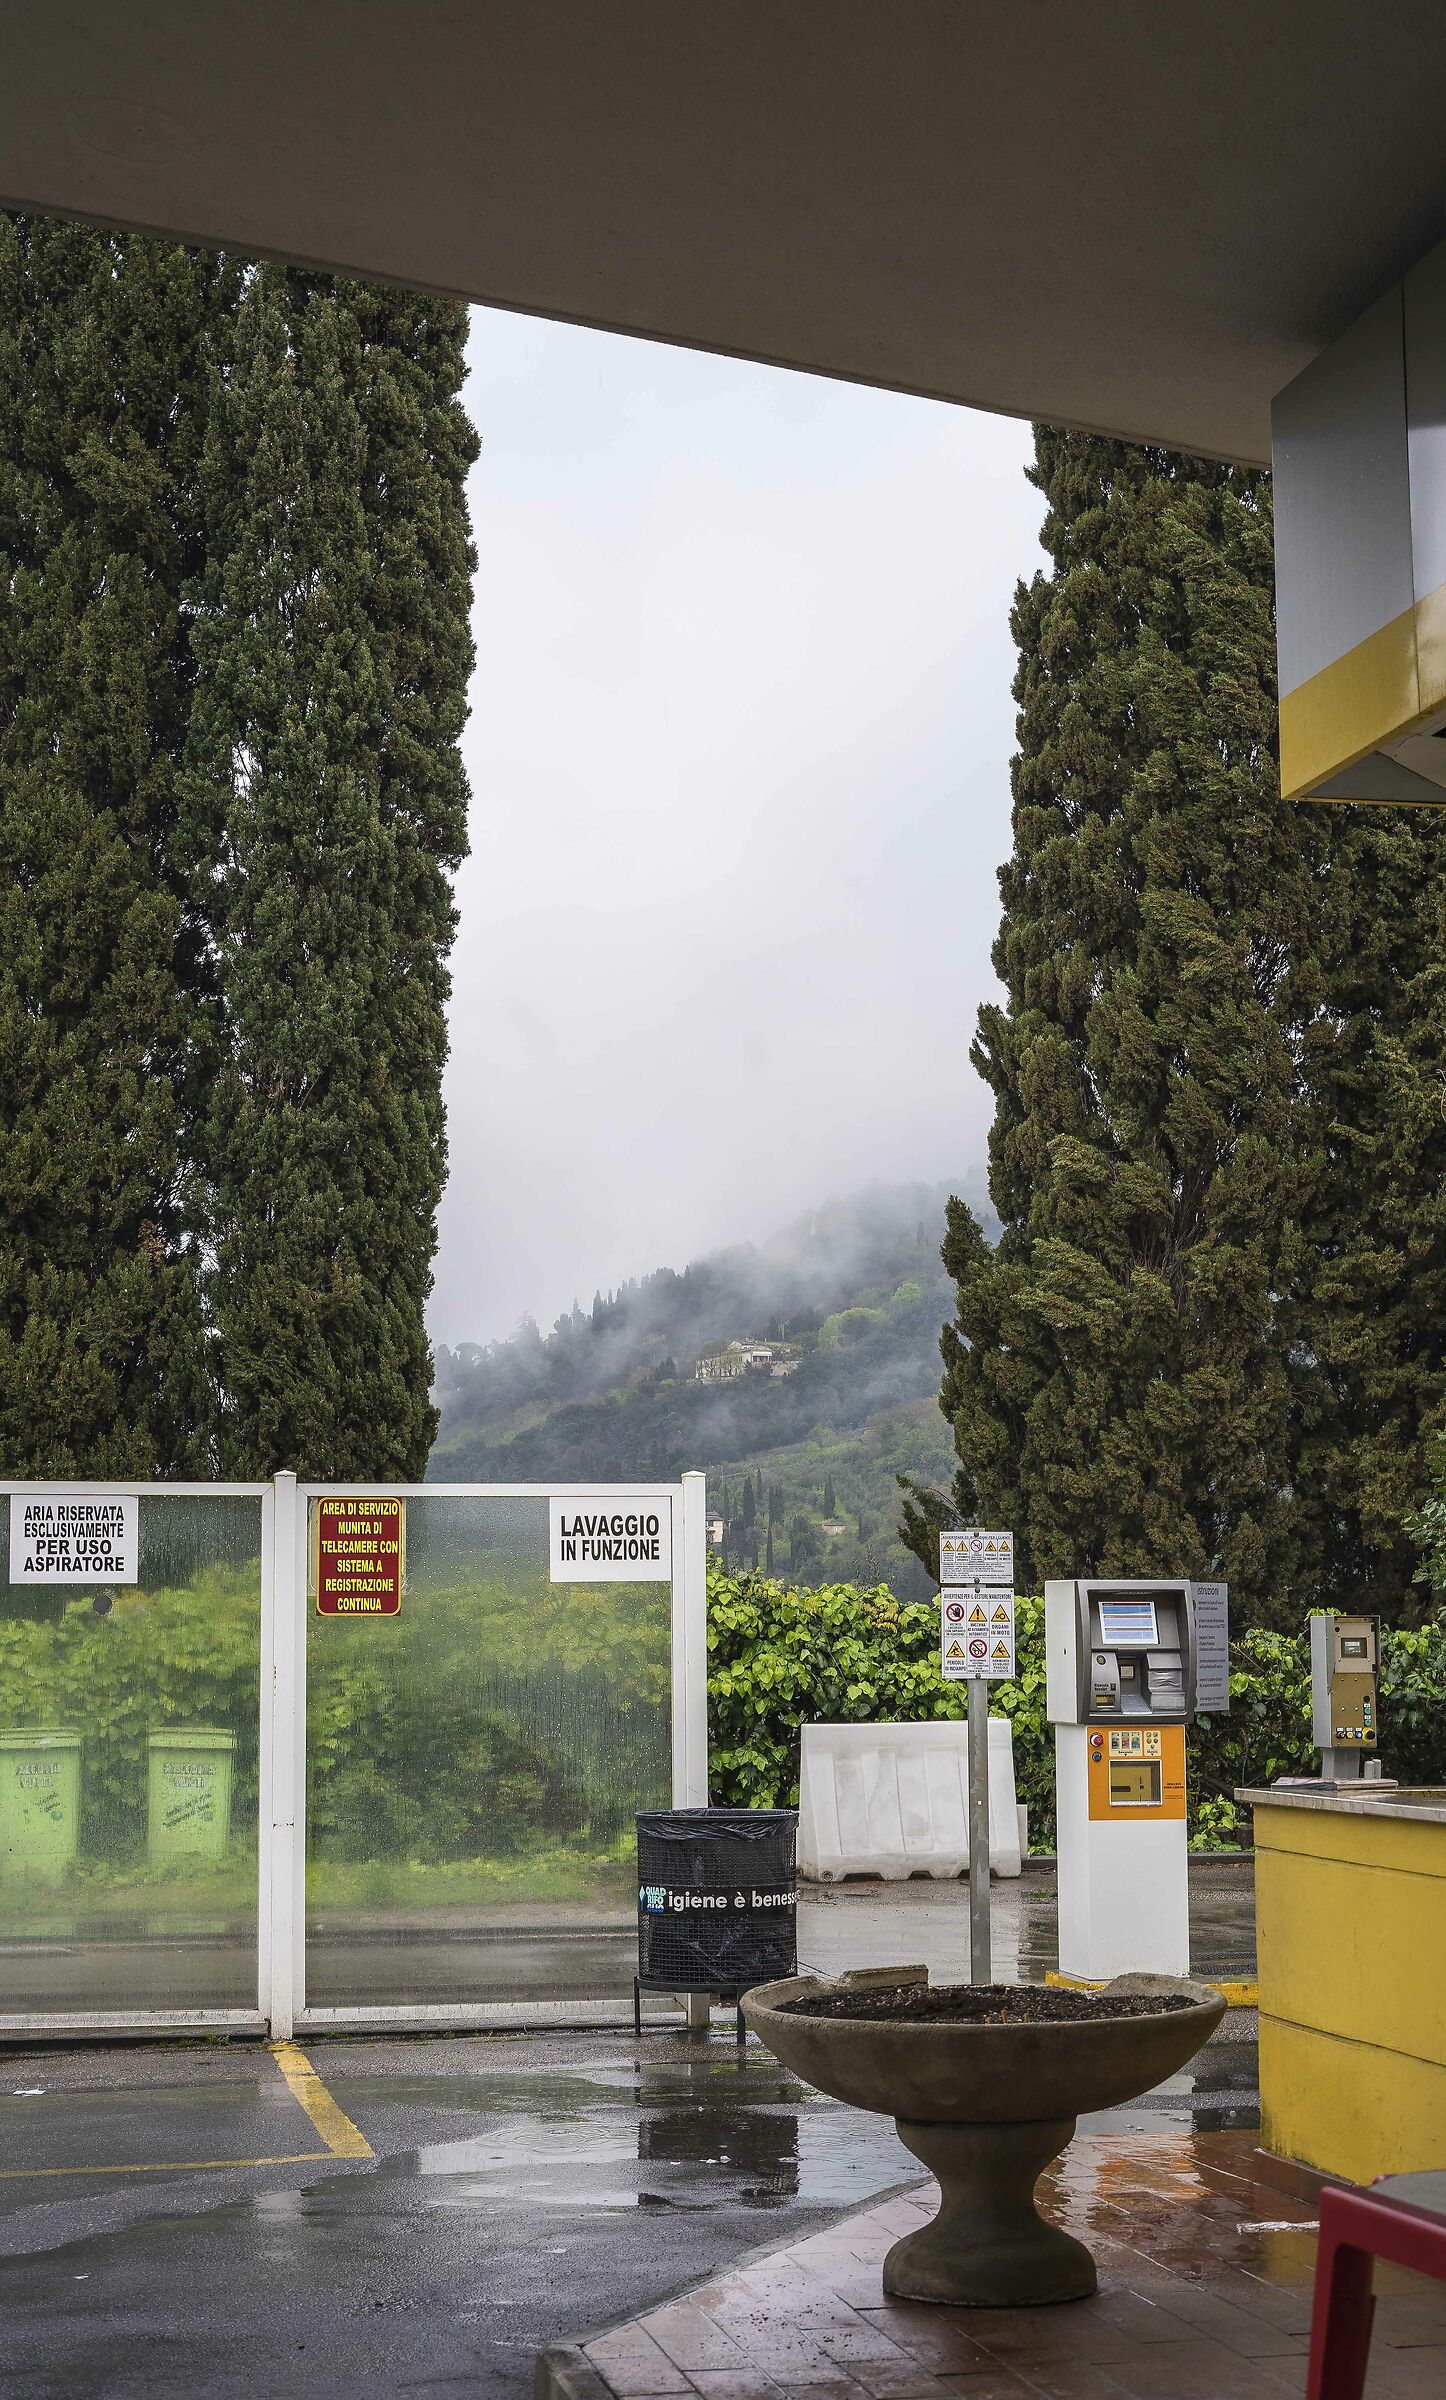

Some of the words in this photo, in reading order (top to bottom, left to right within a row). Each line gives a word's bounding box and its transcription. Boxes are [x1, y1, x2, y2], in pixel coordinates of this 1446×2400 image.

[24, 1506, 54, 1520] ARIA
[58, 1506, 124, 1520] RISERVATA
[322, 1503, 346, 1515] AREA
[347, 1503, 357, 1515] DI
[358, 1503, 398, 1515] SERVIZIO
[24, 1523, 124, 1537] ESCLUSIVAMENTE
[338, 1522, 371, 1534] MUNITA
[373, 1522, 382, 1534] DI
[561, 1515, 659, 1536] LAVAGGIO
[36, 1540, 70, 1554] PER
[76, 1540, 112, 1554] USO
[321, 1541, 378, 1553] TELECAMERE
[380, 1541, 398, 1553] CON
[561, 1540, 576, 1560] IN
[582, 1539, 660, 1560] FUNZIONE
[24, 1557, 124, 1571] ASPIRATORE
[337, 1560, 374, 1572] SISTEMA
[376, 1560, 383, 1572] A
[325, 1579, 394, 1591] REGISTRAZIONE
[337, 1598, 382, 1610] CONTINUA
[646, 1887, 666, 1896] QUAD
[668, 1891, 728, 1911] igiene
[734, 1892, 746, 1908] è
[751, 1890, 797, 1908] beness
